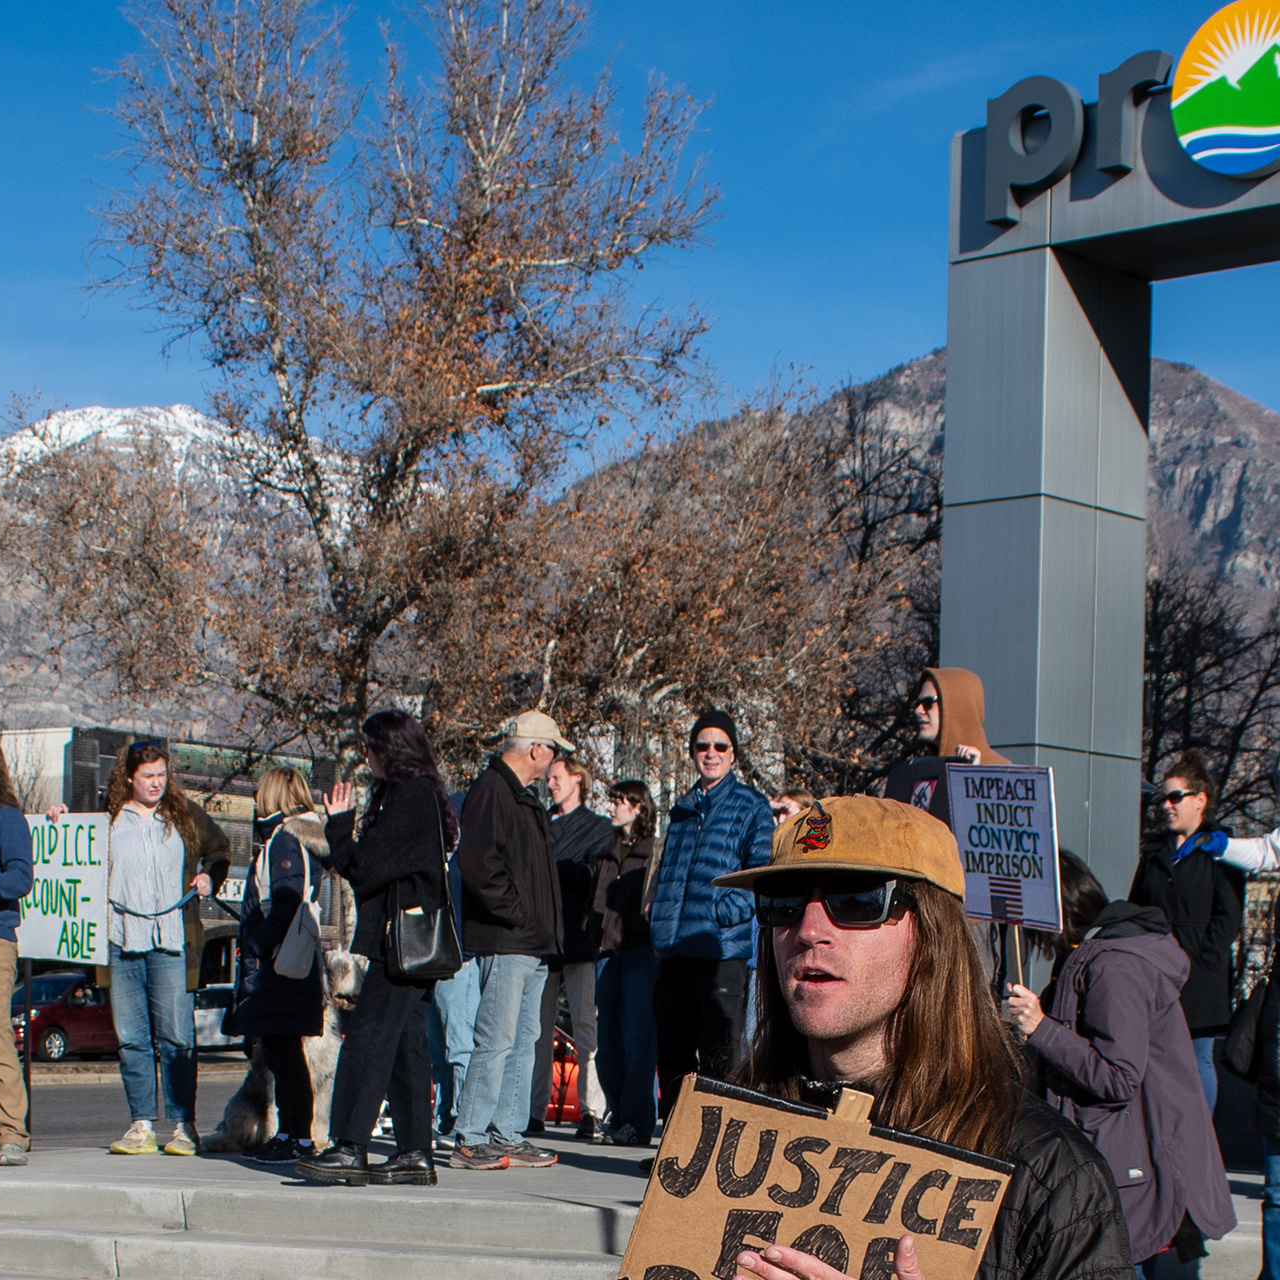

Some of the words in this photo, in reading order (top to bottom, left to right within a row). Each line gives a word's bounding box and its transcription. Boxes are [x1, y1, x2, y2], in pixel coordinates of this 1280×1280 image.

[965, 777, 1036, 801] IMPEACH
[976, 803, 1035, 827] INDICT
[31, 824, 59, 866] OLD
[968, 825, 1040, 855] CONVICT
[964, 850, 1044, 880] IMPRISON
[57, 919, 97, 960] ABLE
[658, 1106, 1002, 1250] JUSTICE
